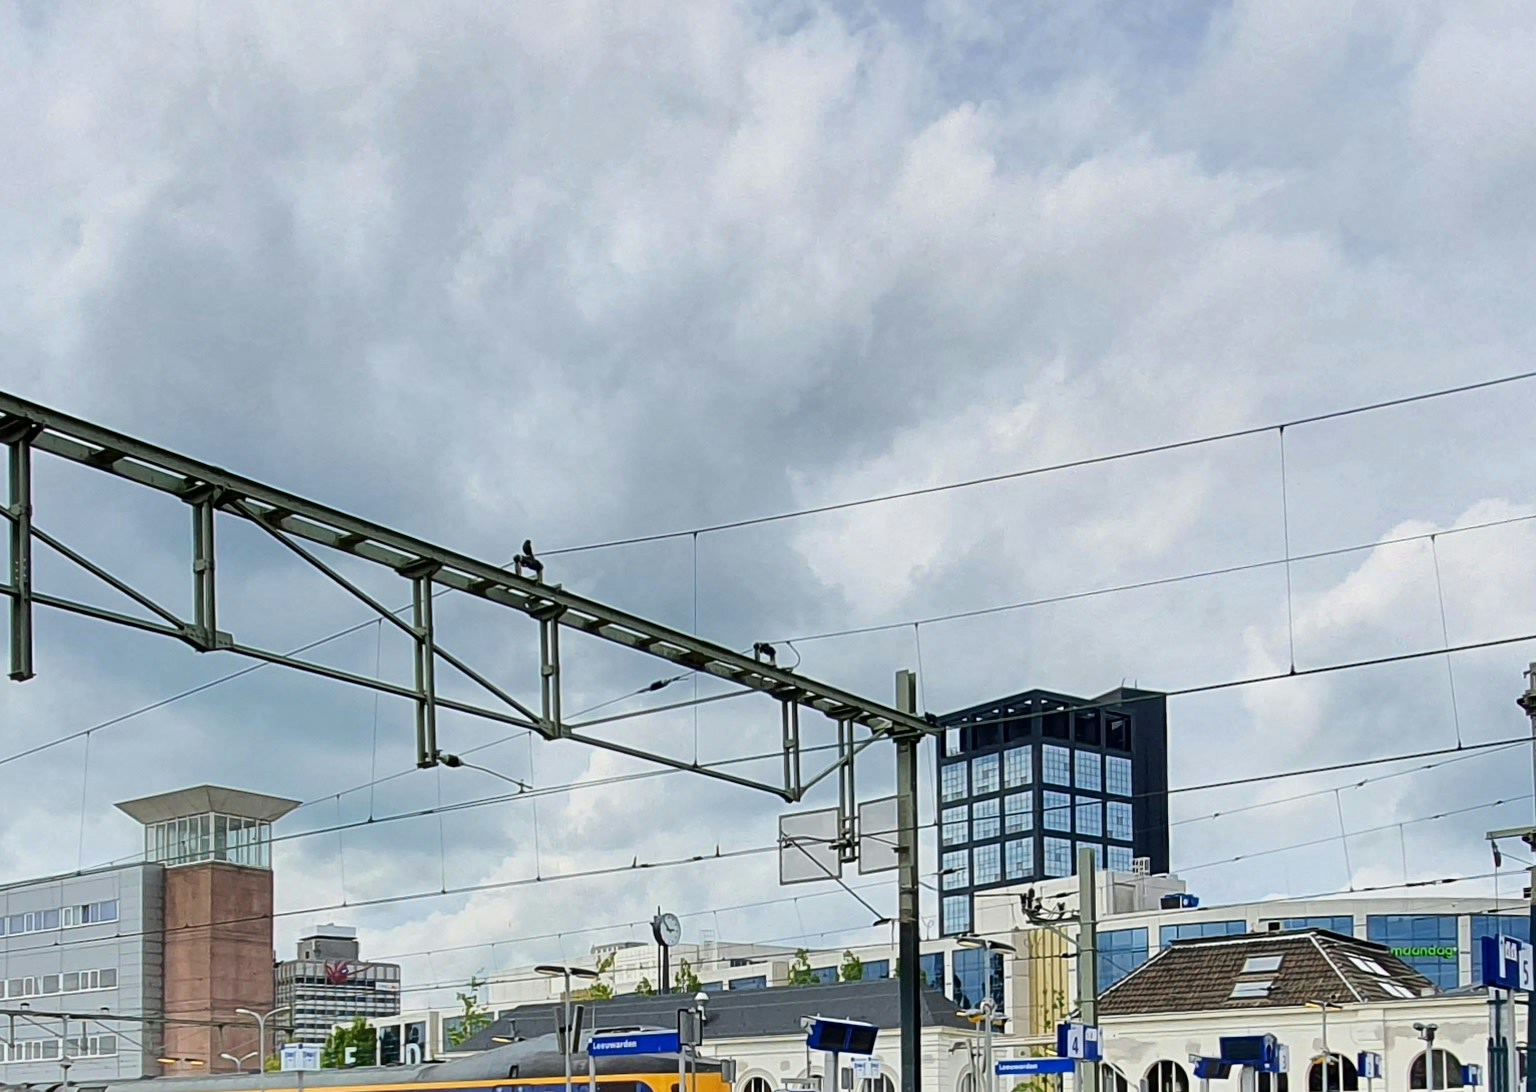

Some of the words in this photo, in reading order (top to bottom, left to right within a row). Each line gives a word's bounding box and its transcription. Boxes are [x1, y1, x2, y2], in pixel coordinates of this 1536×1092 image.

[1523, 960, 1529, 985] 5
[592, 1039, 637, 1050] Leeuwarden
[1072, 1036, 1079, 1055] 4
[999, 1062, 1038, 1071] Leeuwarden
